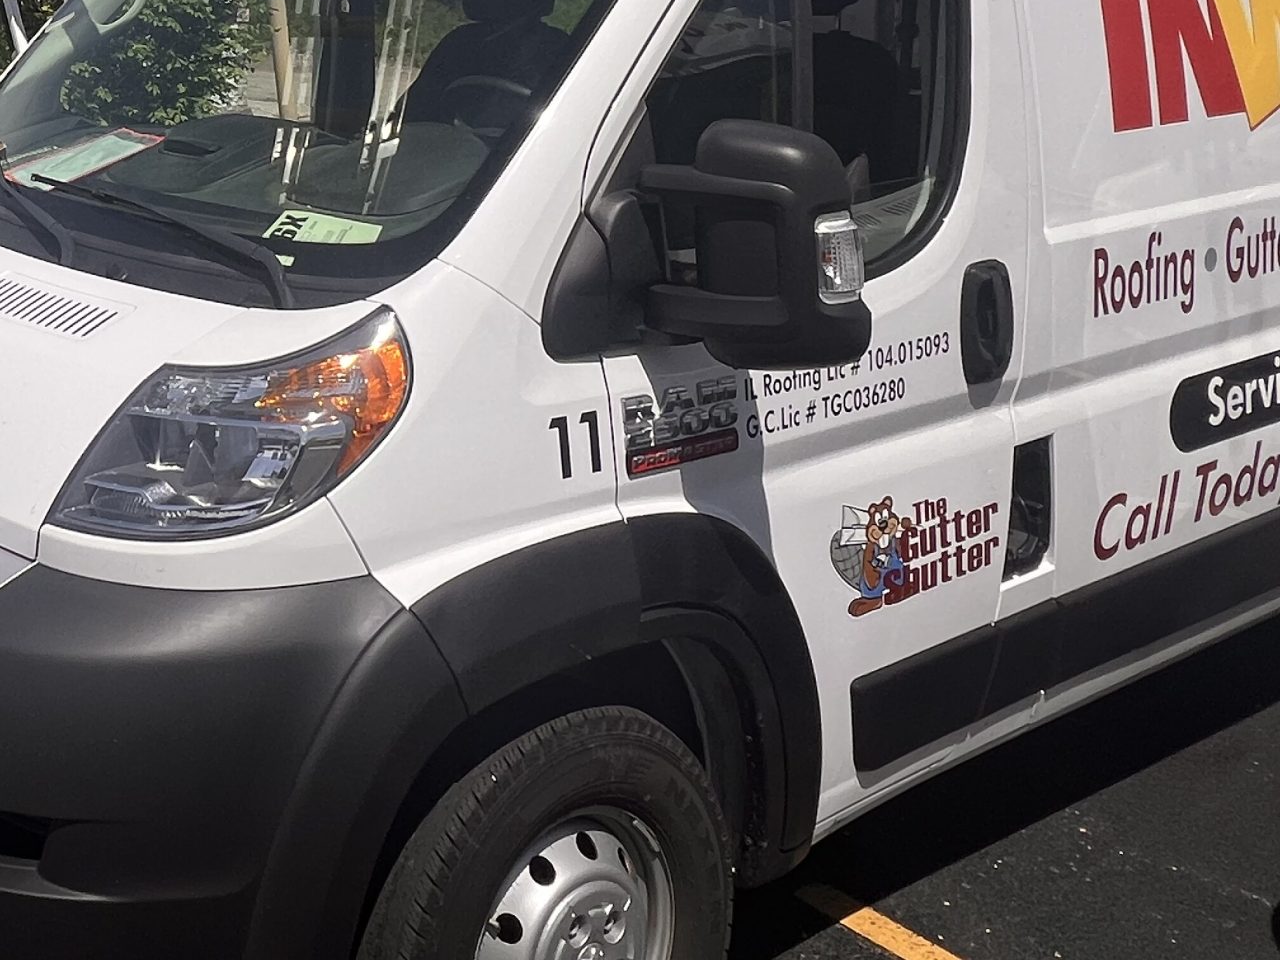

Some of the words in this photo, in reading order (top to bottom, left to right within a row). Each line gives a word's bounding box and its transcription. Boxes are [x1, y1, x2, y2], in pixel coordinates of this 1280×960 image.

[1093, 231, 1195, 318] Roofing
[1226, 215, 1280, 283] Gutt
[744, 377, 758, 402] IL
[763, 369, 821, 398] Roofing
[867, 331, 950, 372] 104.015093
[806, 399, 817, 424] #
[822, 377, 905, 418] TGC036280
[1207, 355, 1280, 426] Servi
[549, 410, 602, 479] 11
[900, 502, 999, 563] Gutter
[912, 497, 948, 526] The
[1093, 469, 1181, 561] Call
[1193, 439, 1280, 523] Toda
[883, 536, 1000, 606] Shutter
